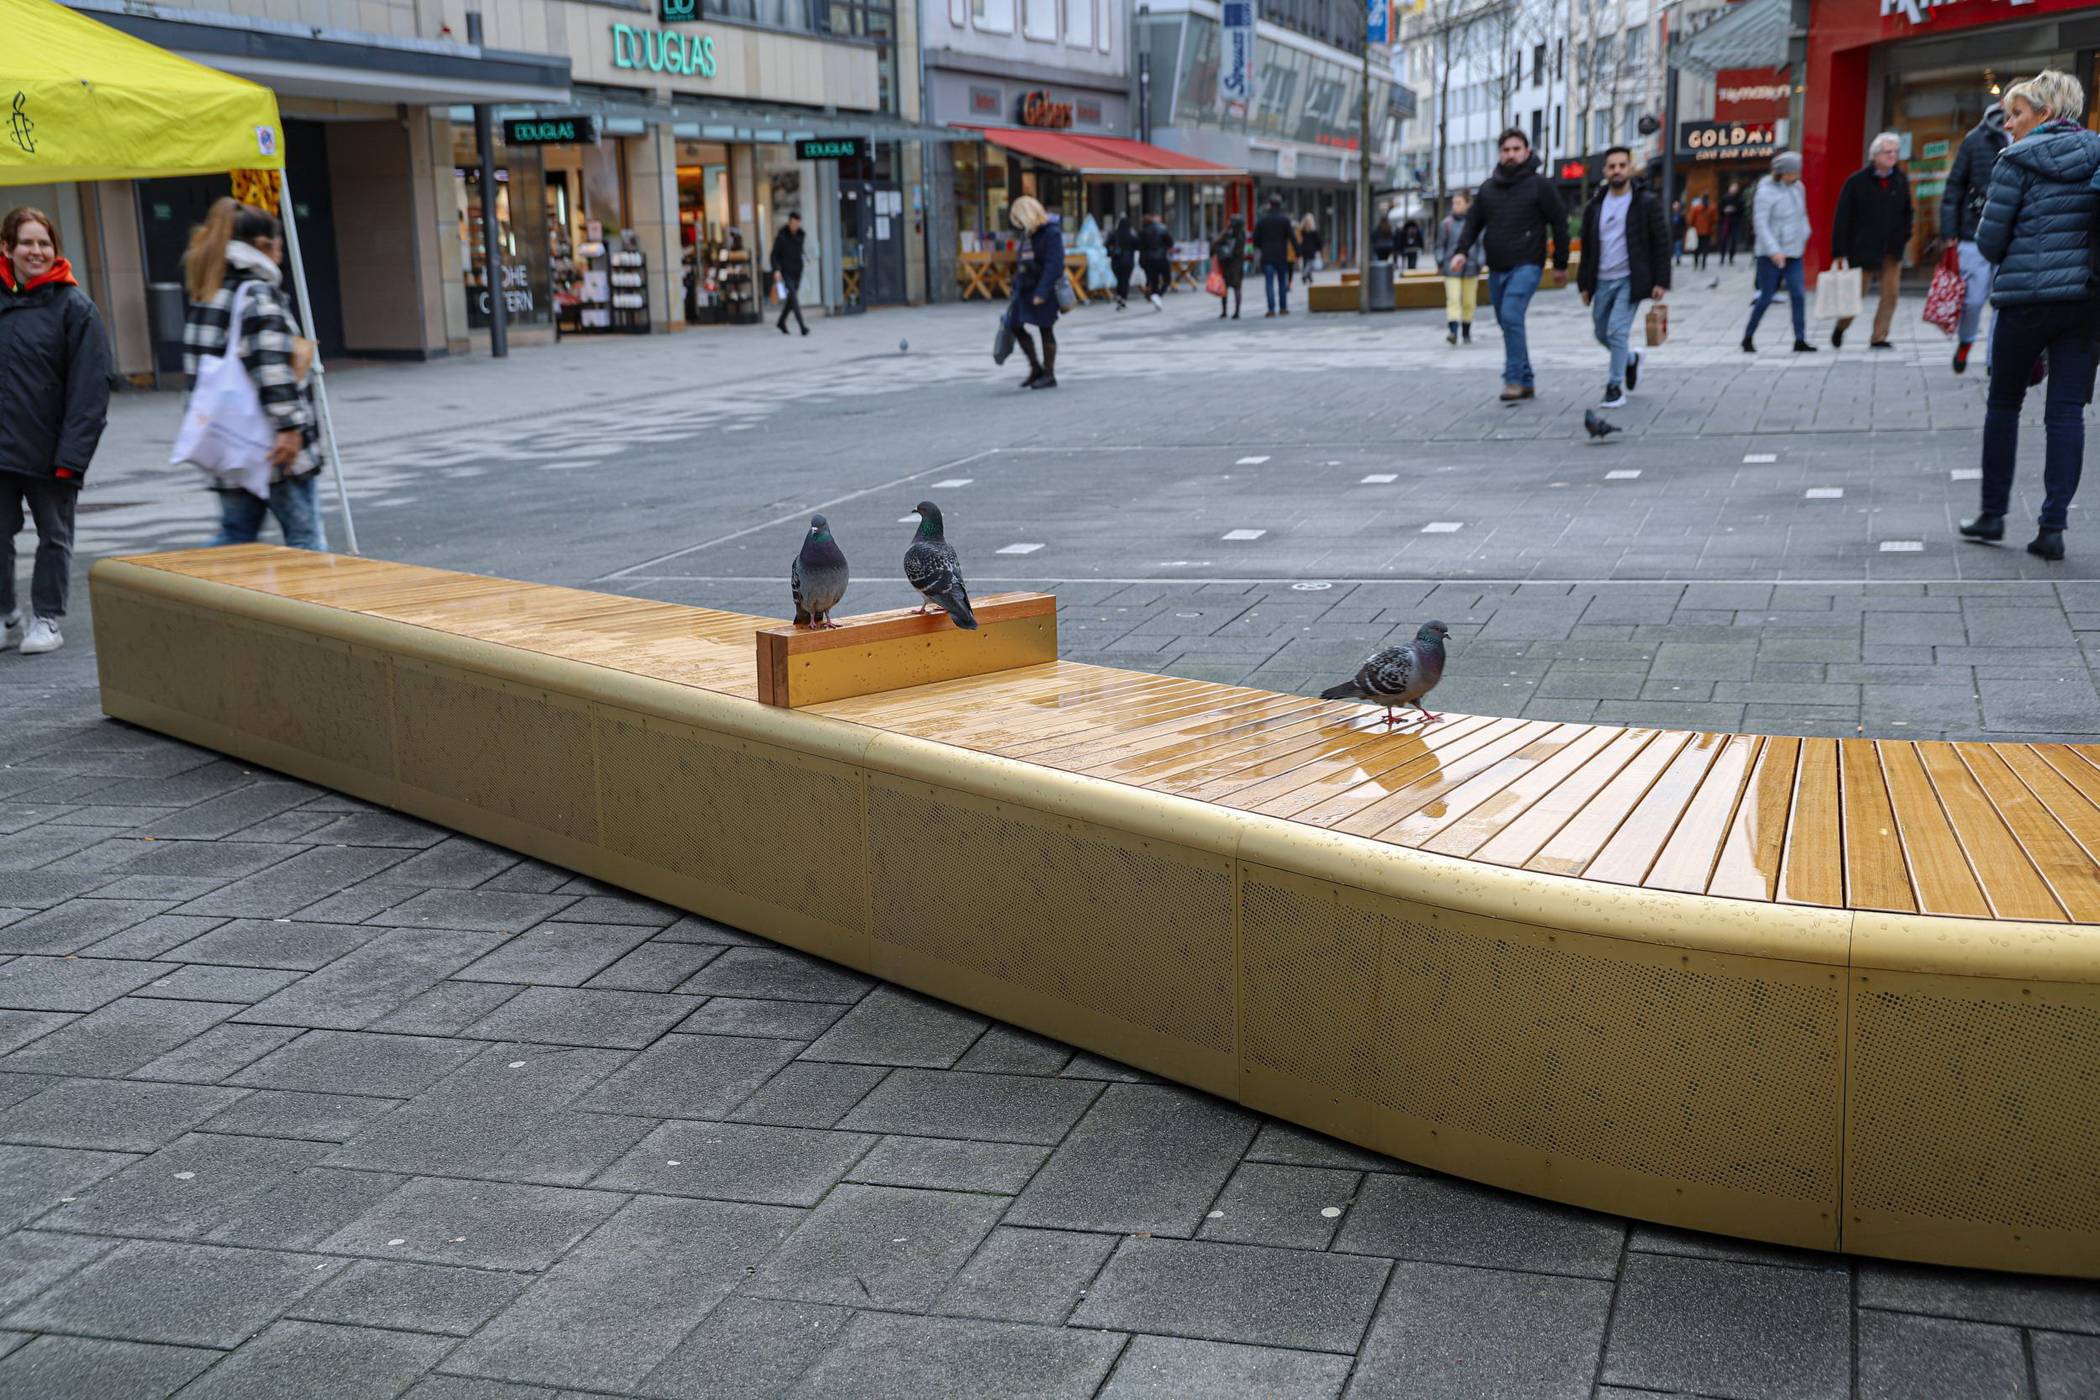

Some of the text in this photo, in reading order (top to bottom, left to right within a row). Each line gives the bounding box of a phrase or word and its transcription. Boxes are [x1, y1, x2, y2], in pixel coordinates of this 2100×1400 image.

[613, 23, 717, 78] DOUGLAS
[514, 121, 575, 141] DOUGLAS
[804, 141, 855, 157] DOUGLAS
